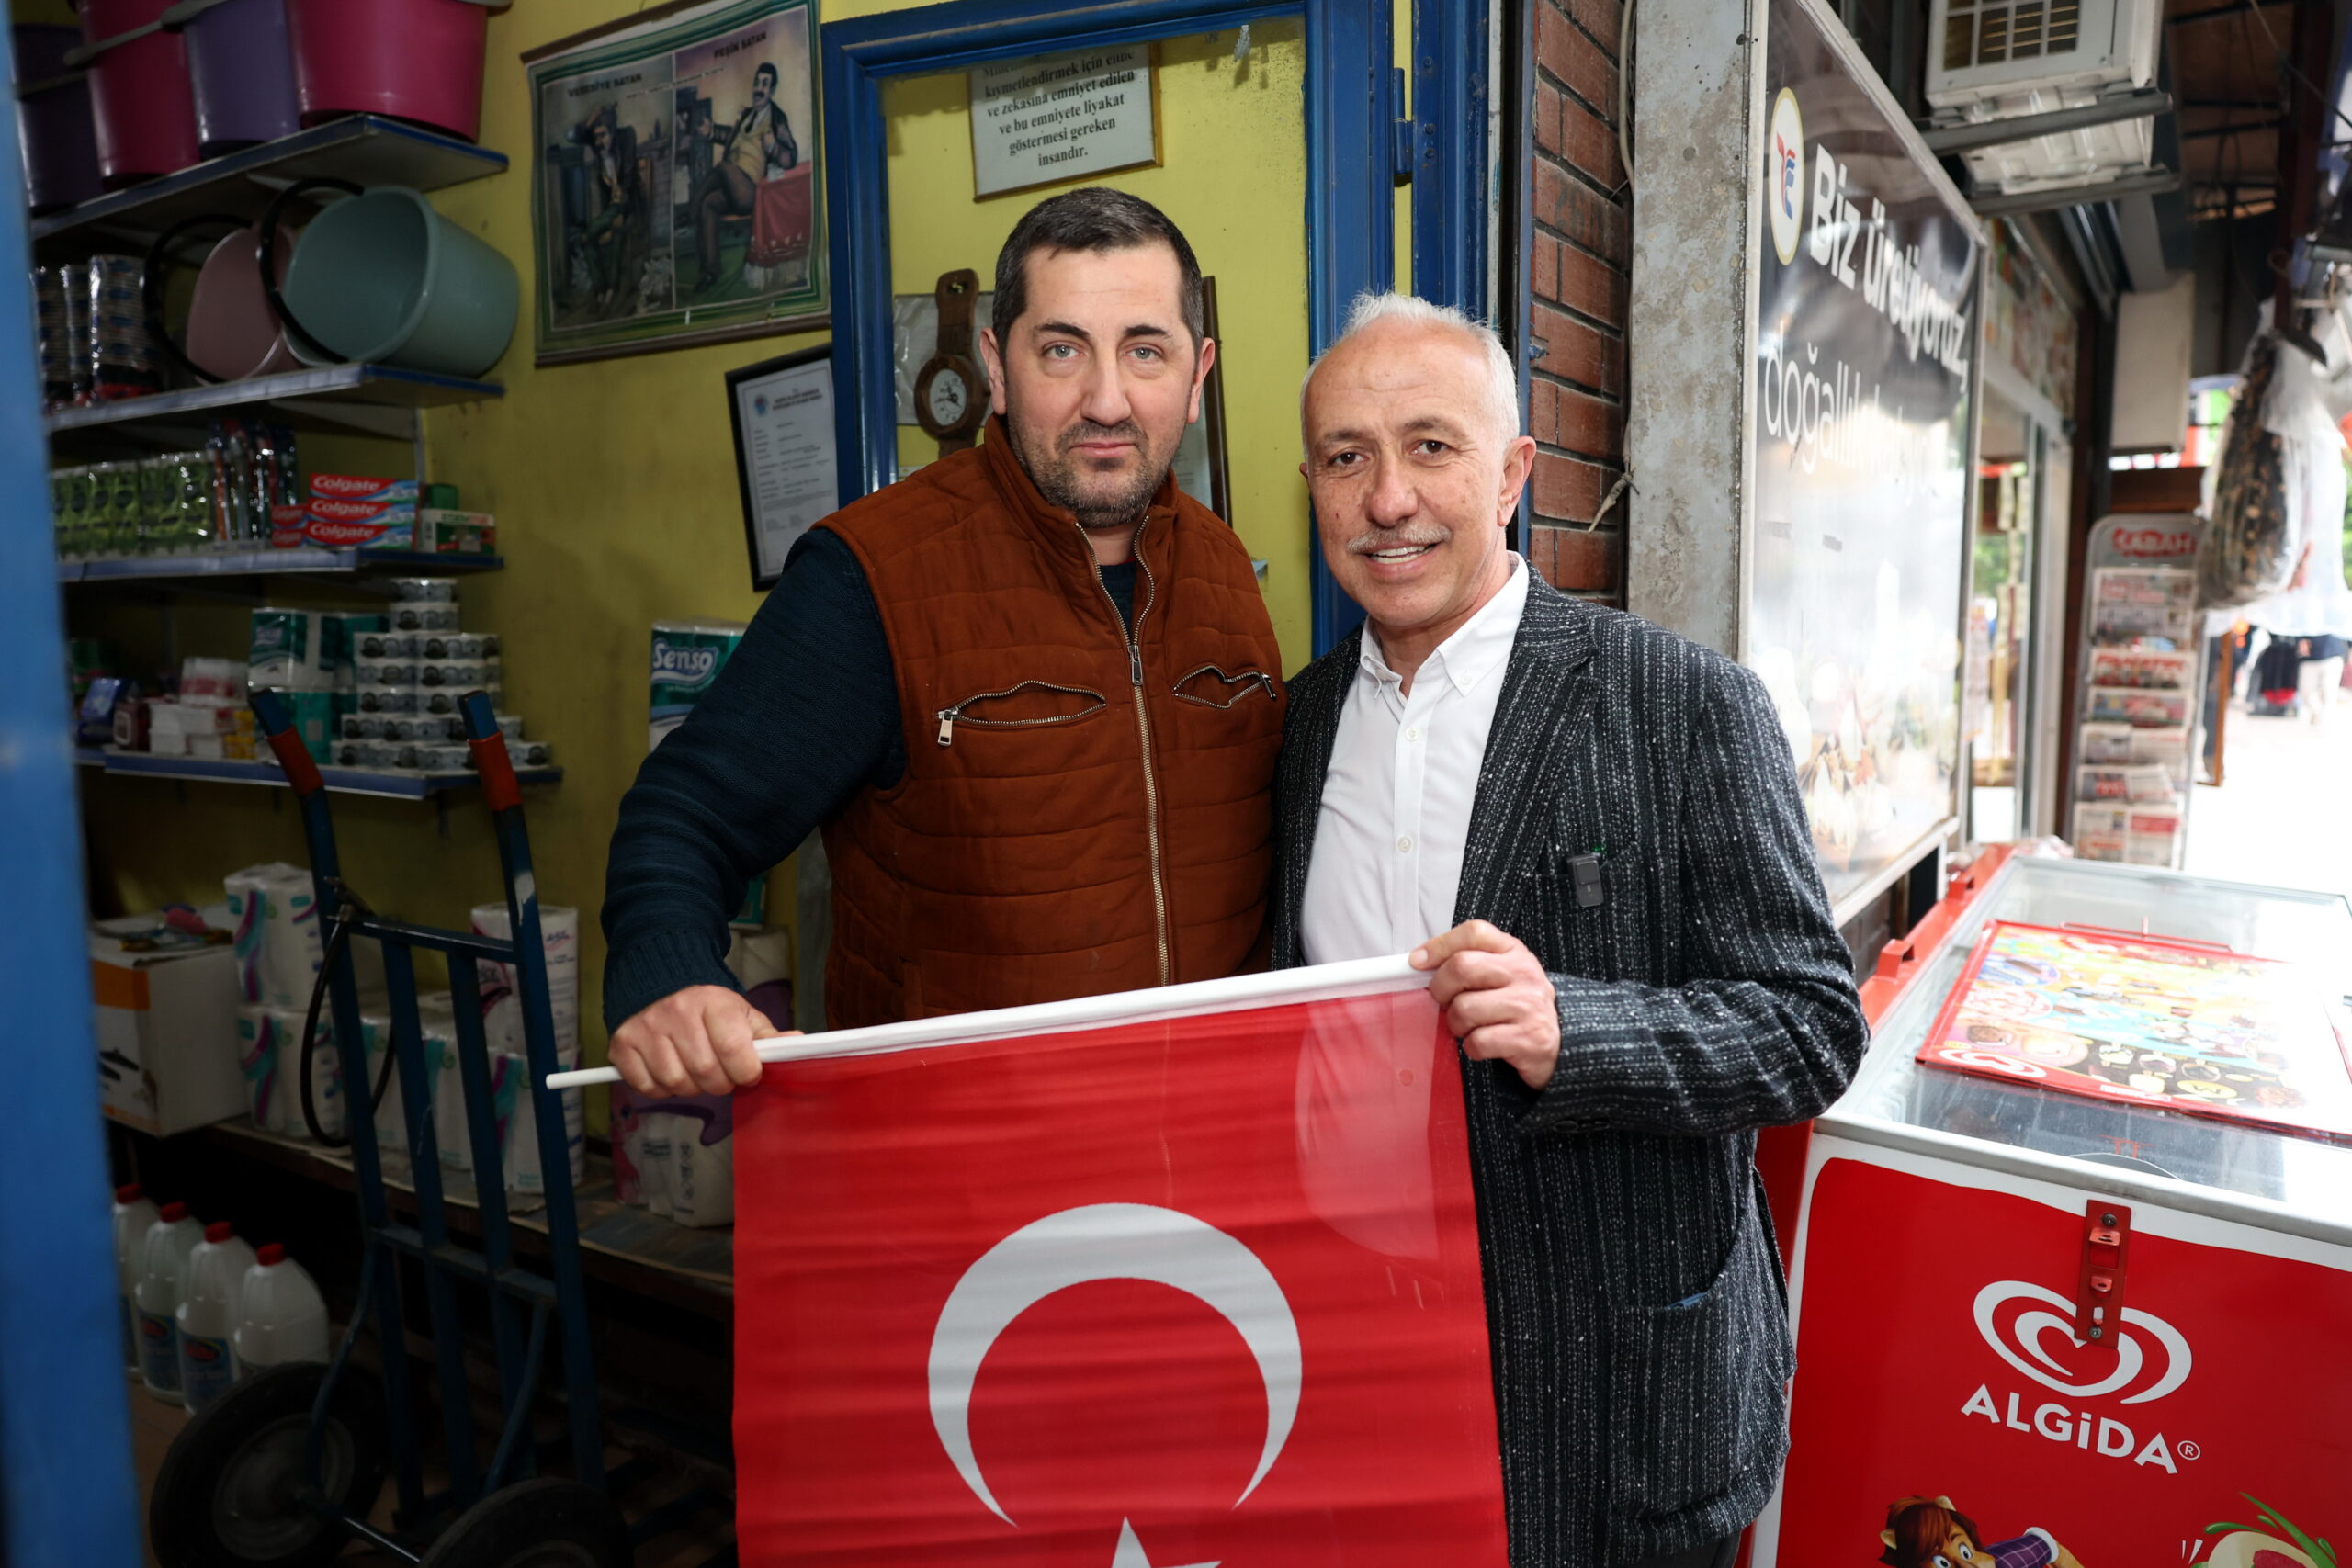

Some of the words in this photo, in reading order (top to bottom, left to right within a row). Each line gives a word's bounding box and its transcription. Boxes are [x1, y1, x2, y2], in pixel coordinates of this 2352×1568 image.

[741, 31, 767, 50] SATAN
[614, 73, 642, 88] SATAN
[985, 62, 1079, 98] kıymetlendirmek
[1081, 56, 1102, 77] için
[987, 106, 999, 118] ve
[1001, 93, 1048, 115] zekasına
[1051, 81, 1096, 103] emniyet
[1099, 70, 1135, 88] edilen
[999, 122, 1011, 135] ve
[1014, 117, 1028, 131] bu
[1031, 104, 1081, 127] emniyete
[1084, 93, 1125, 117] liyakat
[1009, 127, 1068, 156] göstermesi
[1070, 118, 1116, 141] gereken
[1038, 145, 1089, 166] insandır.
[1810, 143, 1861, 291] Biz
[312, 474, 380, 493] Colgate
[311, 499, 378, 516] Colgate
[309, 522, 376, 538] Colgate
[653, 642, 713, 671] Senso
